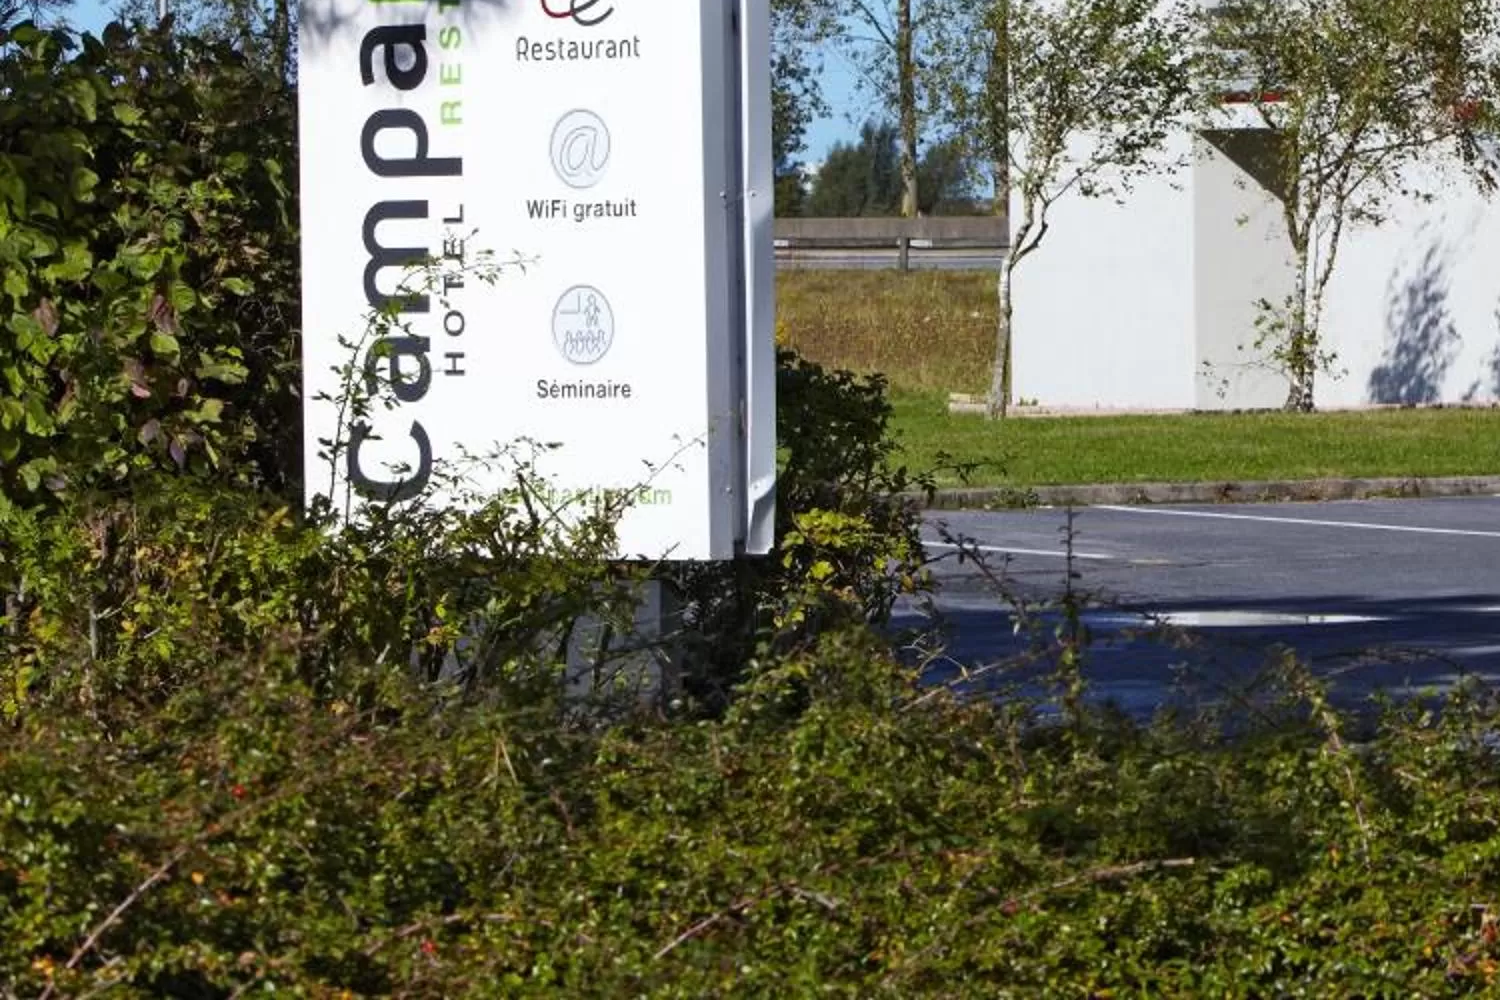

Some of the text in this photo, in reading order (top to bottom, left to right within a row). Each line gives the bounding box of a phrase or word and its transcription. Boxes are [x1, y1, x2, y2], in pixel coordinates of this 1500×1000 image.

[515, 35, 641, 62] Restaurant
[526, 197, 637, 222] WiFi gratuit
[443, 204, 466, 377] HOTEL
[536, 379, 632, 399] Séminaire
